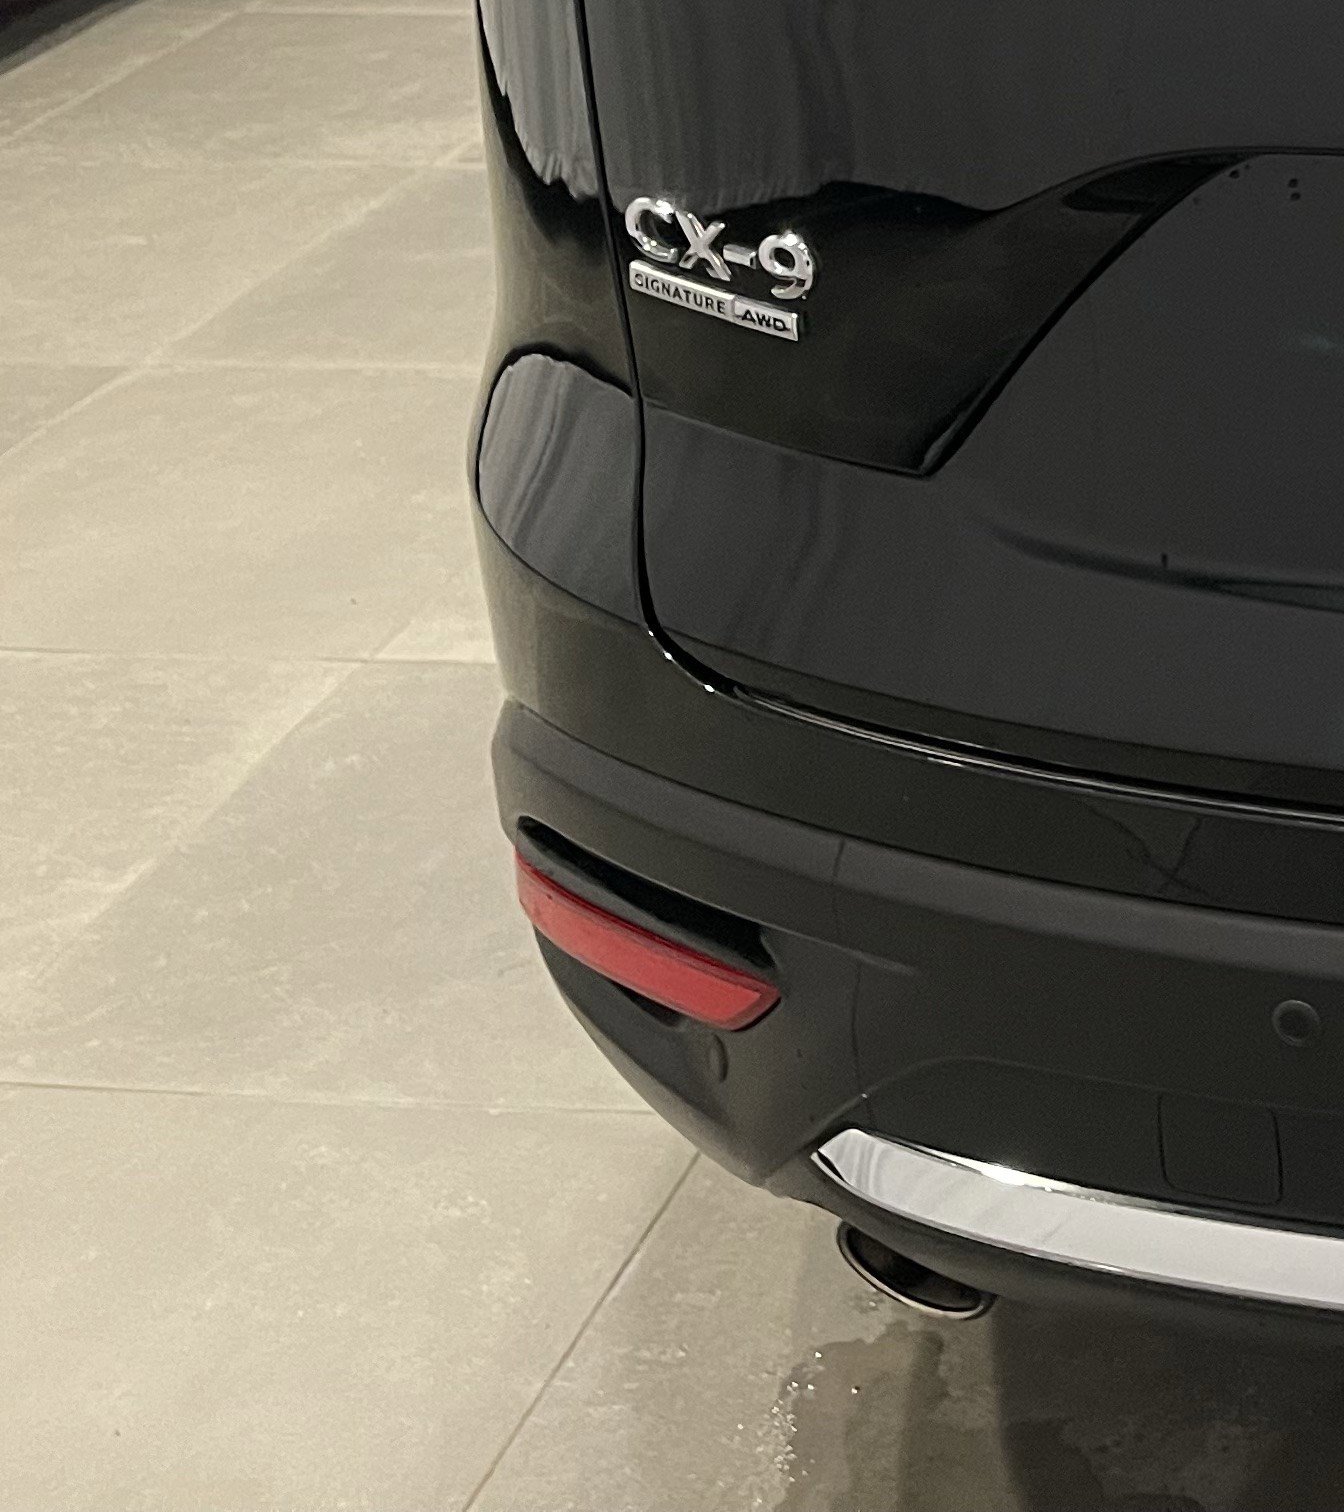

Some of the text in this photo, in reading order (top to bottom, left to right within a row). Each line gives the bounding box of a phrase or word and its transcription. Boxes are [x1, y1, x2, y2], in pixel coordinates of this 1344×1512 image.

[625, 197, 814, 299] CX-9
[634, 273, 788, 332] SIGNATURE AWD
